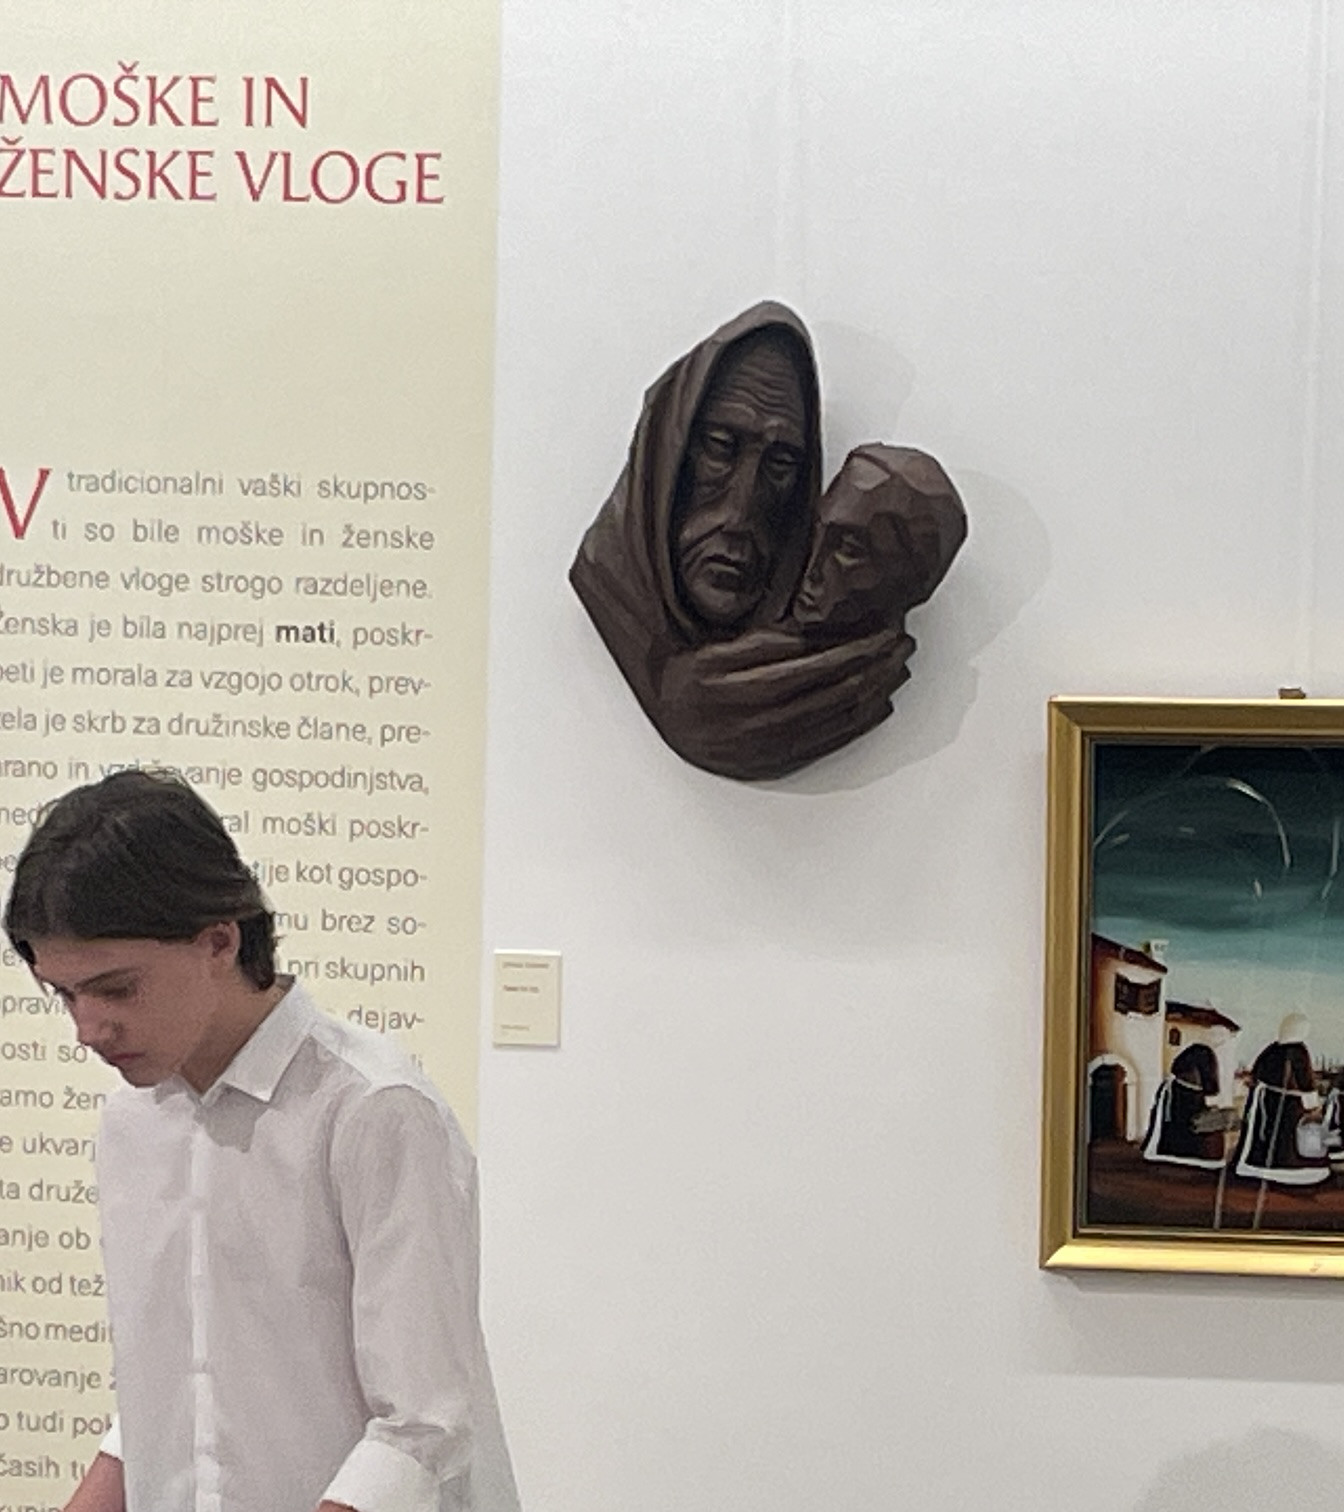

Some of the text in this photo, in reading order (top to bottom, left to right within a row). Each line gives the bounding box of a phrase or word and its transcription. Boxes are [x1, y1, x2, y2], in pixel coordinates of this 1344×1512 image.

[241, 76, 311, 129] IN
[234, 149, 446, 205] VLOGE
[67, 471, 225, 496] tradicionalni
[238, 473, 302, 498] vaški
[317, 476, 436, 505] skupnos-
[52, 518, 436, 551] ti so bile moške in ženske
[120, 567, 191, 597] vloge
[201, 571, 284, 601] strogo
[89, 615, 112, 644] je
[122, 613, 167, 640] bila
[177, 615, 265, 647] najprej
[352, 621, 434, 651] poskr-
[42, 661, 65, 690] je
[71, 662, 158, 688] morala
[165, 668, 193, 688] za
[199, 668, 283, 697] vzgojo
[289, 669, 361, 697] otrok,
[368, 674, 432, 699] prev-
[43, 709, 67, 738] je
[72, 709, 127, 735] skrb
[132, 716, 161, 736] za
[167, 713, 291, 740] družinske
[297, 713, 373, 746] člane,
[379, 722, 432, 748] pre-
[68, 757, 90, 781] in
[262, 811, 337, 837] moški
[349, 815, 430, 842] poskr-
[296, 860, 332, 884] kot
[338, 866, 428, 891] gospo-
[321, 909, 376, 934] brez
[387, 916, 428, 936] so-
[325, 957, 426, 987] skupnih
[58, 1226, 92, 1251] ob
[31, 1271, 63, 1295] od
[16, 1409, 65, 1433] tudi
